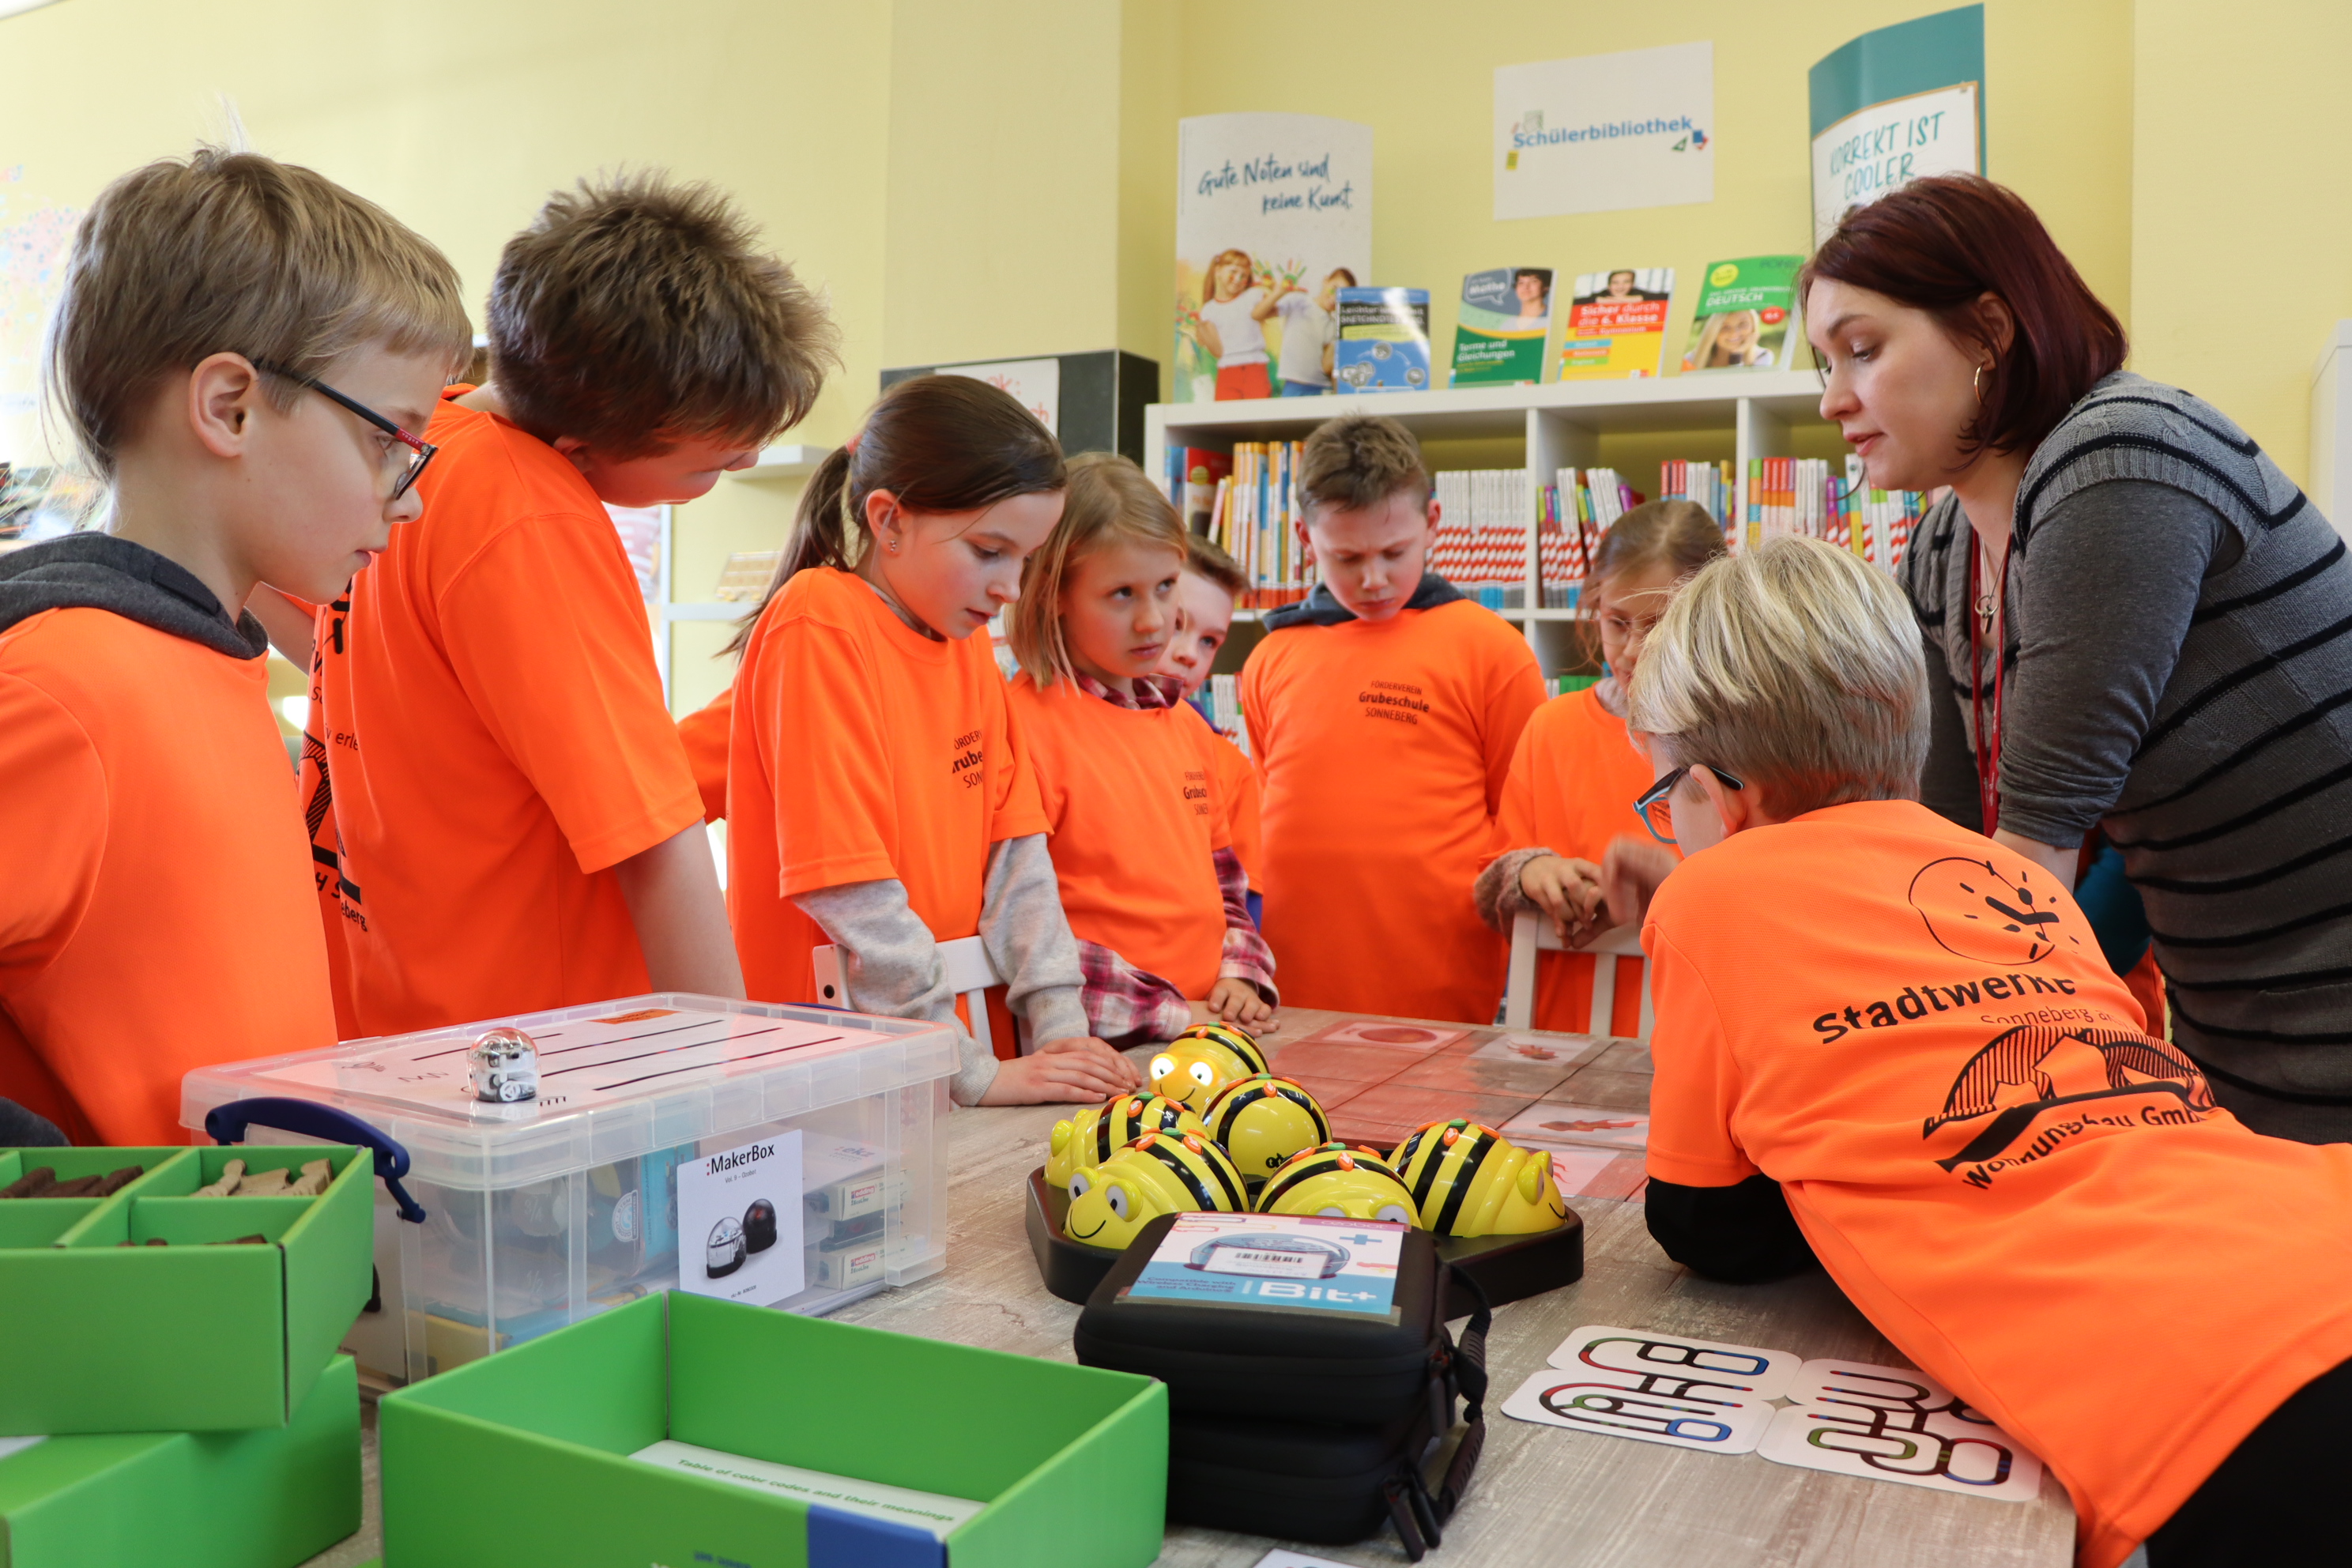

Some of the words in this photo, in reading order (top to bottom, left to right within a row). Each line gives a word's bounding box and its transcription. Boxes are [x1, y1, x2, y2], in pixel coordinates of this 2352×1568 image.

[1513, 115, 1692, 148] Schülerbibliothek
[1830, 122, 1901, 175] KORREKT
[1908, 111, 1945, 148] IST
[1198, 160, 1239, 195] Gute
[1244, 153, 1292, 186] Noten
[1298, 153, 1331, 183] sind
[1845, 152, 1915, 199] COOLER
[1263, 192, 1302, 215] keine
[1706, 292, 1763, 307] DEUTSCH
[1581, 304, 1620, 316] Sicher
[1623, 302, 1660, 313] durch
[1578, 317, 1599, 326] die
[1615, 313, 1658, 324] Klasse
[1459, 342, 1486, 352] Terme
[1489, 339, 1507, 349] und
[1457, 349, 1515, 362] Gleichungen
[1370, 680, 1422, 695] FÖRDERVEREIN
[1359, 691, 1430, 712] Grubeschule
[1366, 707, 1418, 725] SONNEBERG
[952, 750, 983, 774] rube
[855, 1185, 874, 1197] edding
[1321, 1220, 1388, 1229] ozobot
[855, 1254, 875, 1265] edding
[678, 1459, 713, 1471] Table
[733, 1472, 767, 1483] color
[769, 1480, 810, 1492] codes
[812, 1489, 842, 1498] and
[844, 1494, 880, 1506] their
[881, 1503, 955, 1521] meanings
